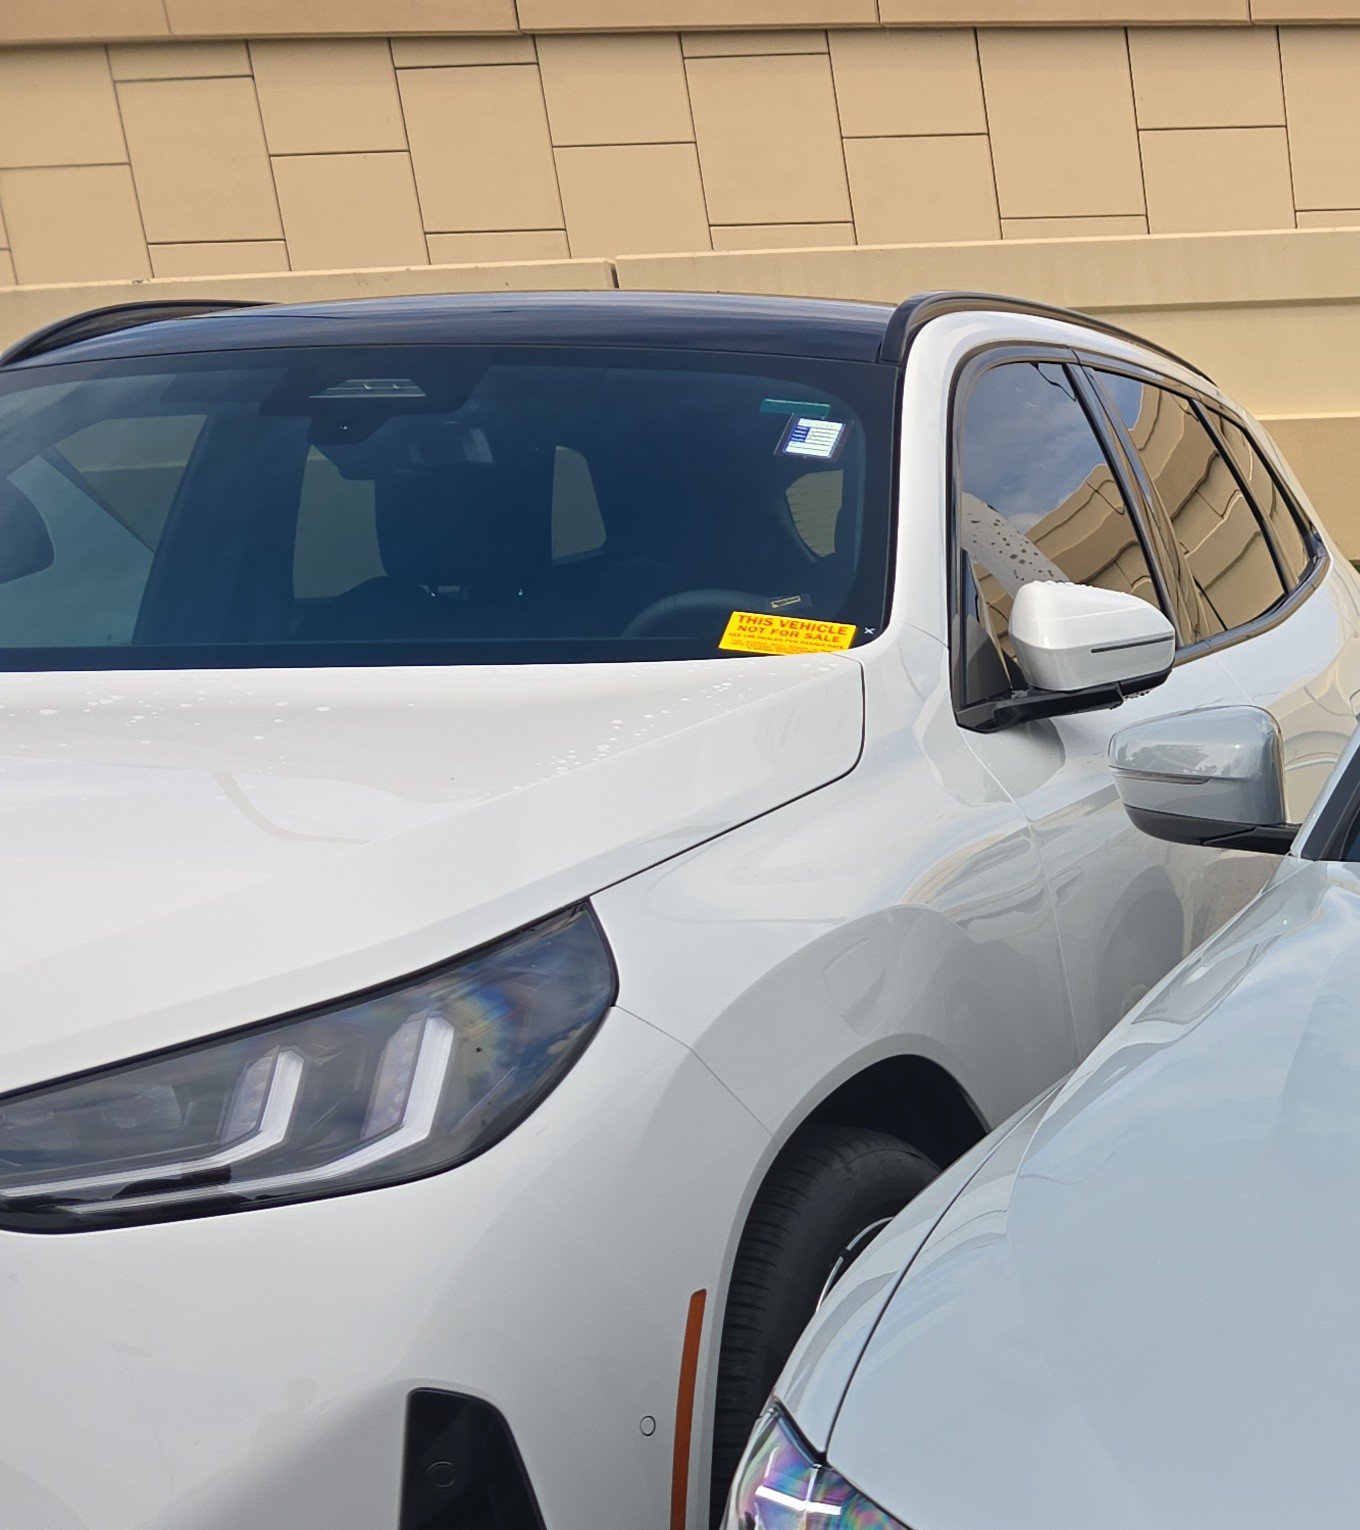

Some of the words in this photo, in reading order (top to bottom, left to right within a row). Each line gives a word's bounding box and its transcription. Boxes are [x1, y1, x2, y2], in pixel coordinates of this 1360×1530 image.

[737, 625, 765, 633] NOT
[770, 628, 799, 638] FOR
[804, 632, 841, 643] SALE
[738, 615, 774, 627] THIS
[779, 619, 849, 636] VEHICLE
